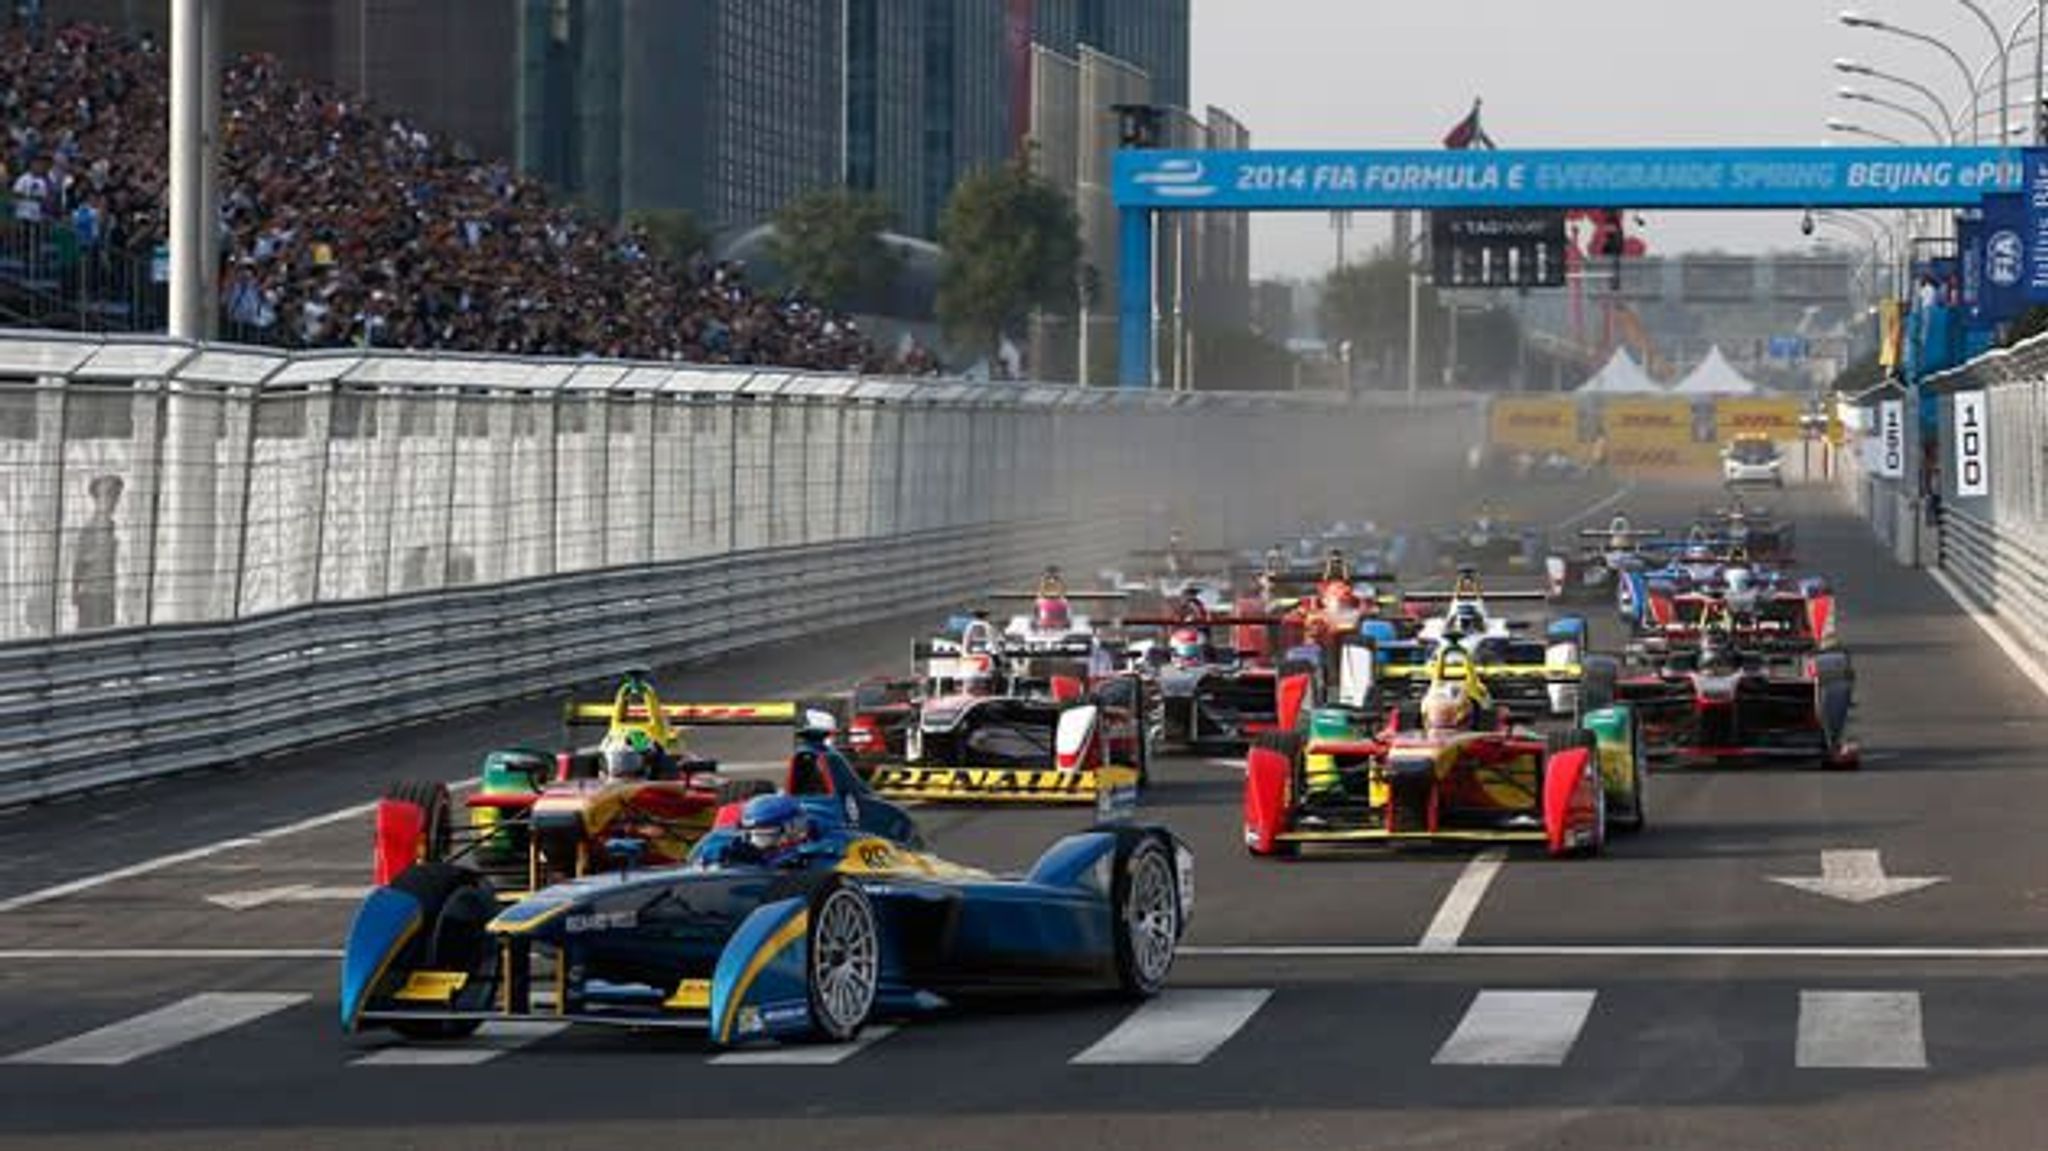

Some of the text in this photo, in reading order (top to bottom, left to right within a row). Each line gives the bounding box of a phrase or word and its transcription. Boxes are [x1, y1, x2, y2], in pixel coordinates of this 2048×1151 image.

[1237, 165, 1305, 189] 2014
[1312, 165, 1357, 189] FIA
[1364, 165, 1498, 189] FORMULA
[1506, 165, 1526, 189] E
[1847, 162, 1952, 192] BEIJING
[1992, 239, 2016, 282] FIA
[1886, 411, 1900, 470] 150
[1963, 404, 1981, 486] 100
